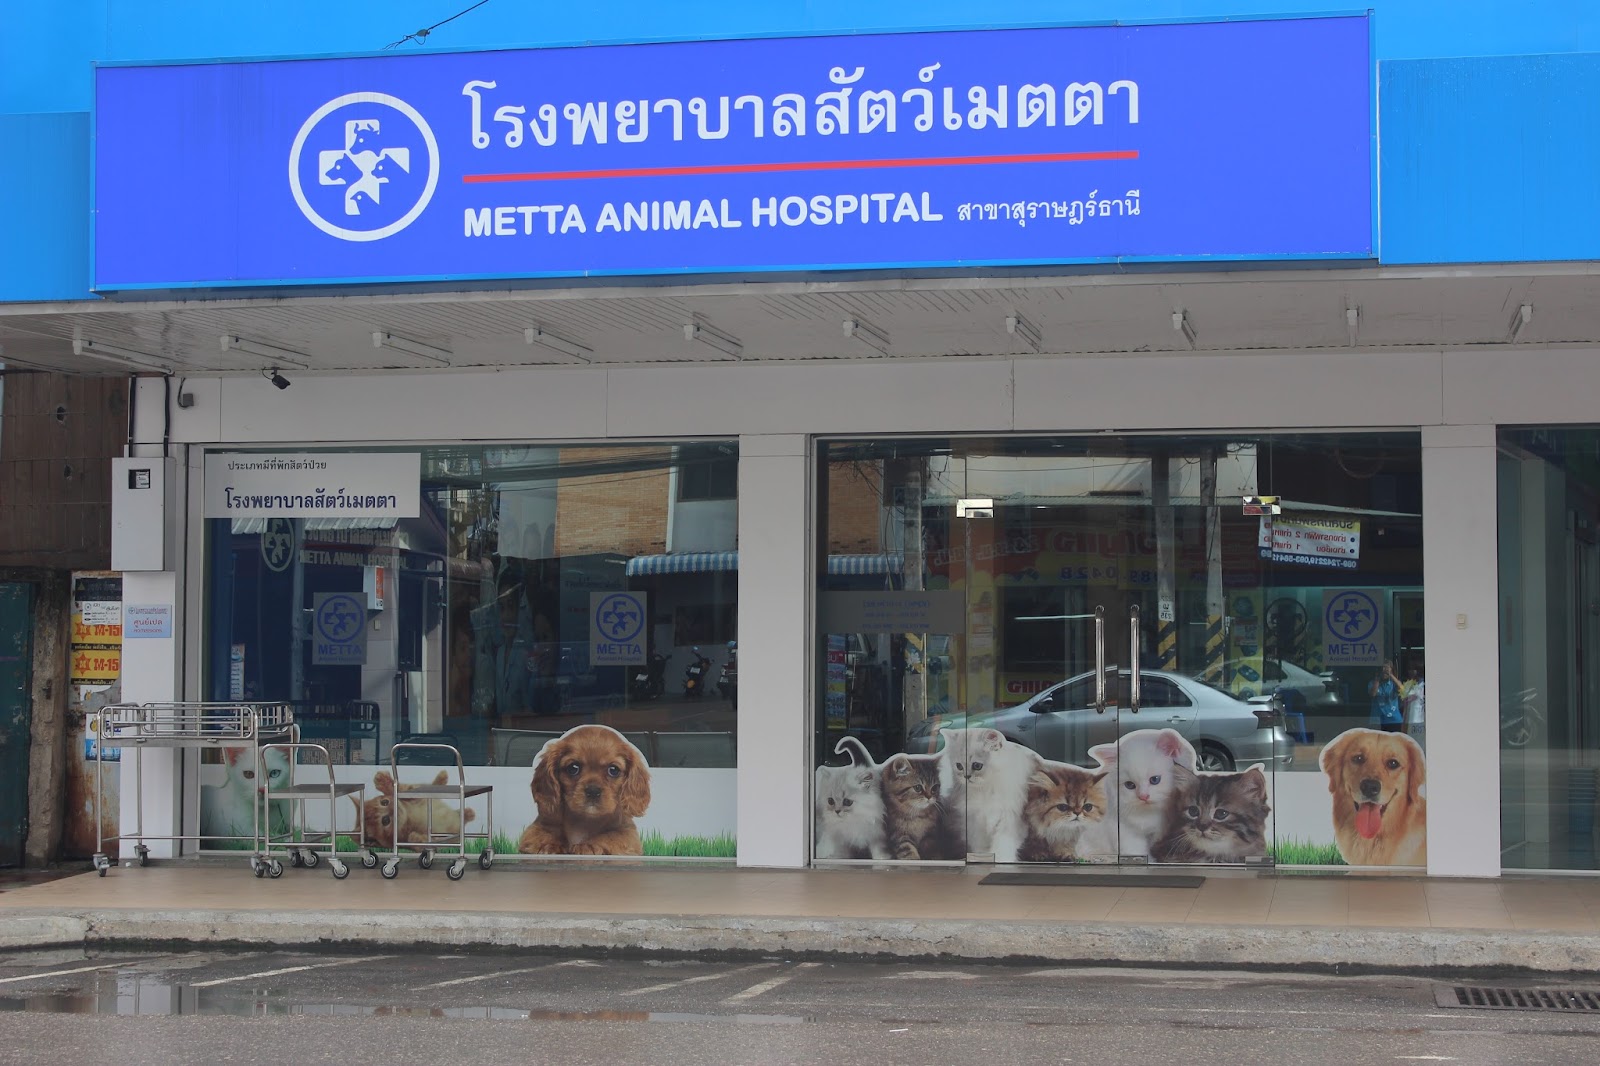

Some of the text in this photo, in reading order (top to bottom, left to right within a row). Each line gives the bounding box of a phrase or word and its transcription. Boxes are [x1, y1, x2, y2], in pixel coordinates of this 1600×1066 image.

[462, 62, 1139, 149] โรงพยาบาลสัตว์เมตตา
[464, 189, 1141, 238] METTA ANIMAL HOSPITAL สาขาสุราษฎร์ธานี
[227, 457, 327, 471] ประเภทมีที่พักสัตว์ป่วย
[224, 487, 397, 509] โรงพยาบาลสัตว์เมตตา
[318, 644, 362, 655] METTA
[597, 643, 641, 655] METTA
[1328, 643, 1377, 655] METTA
